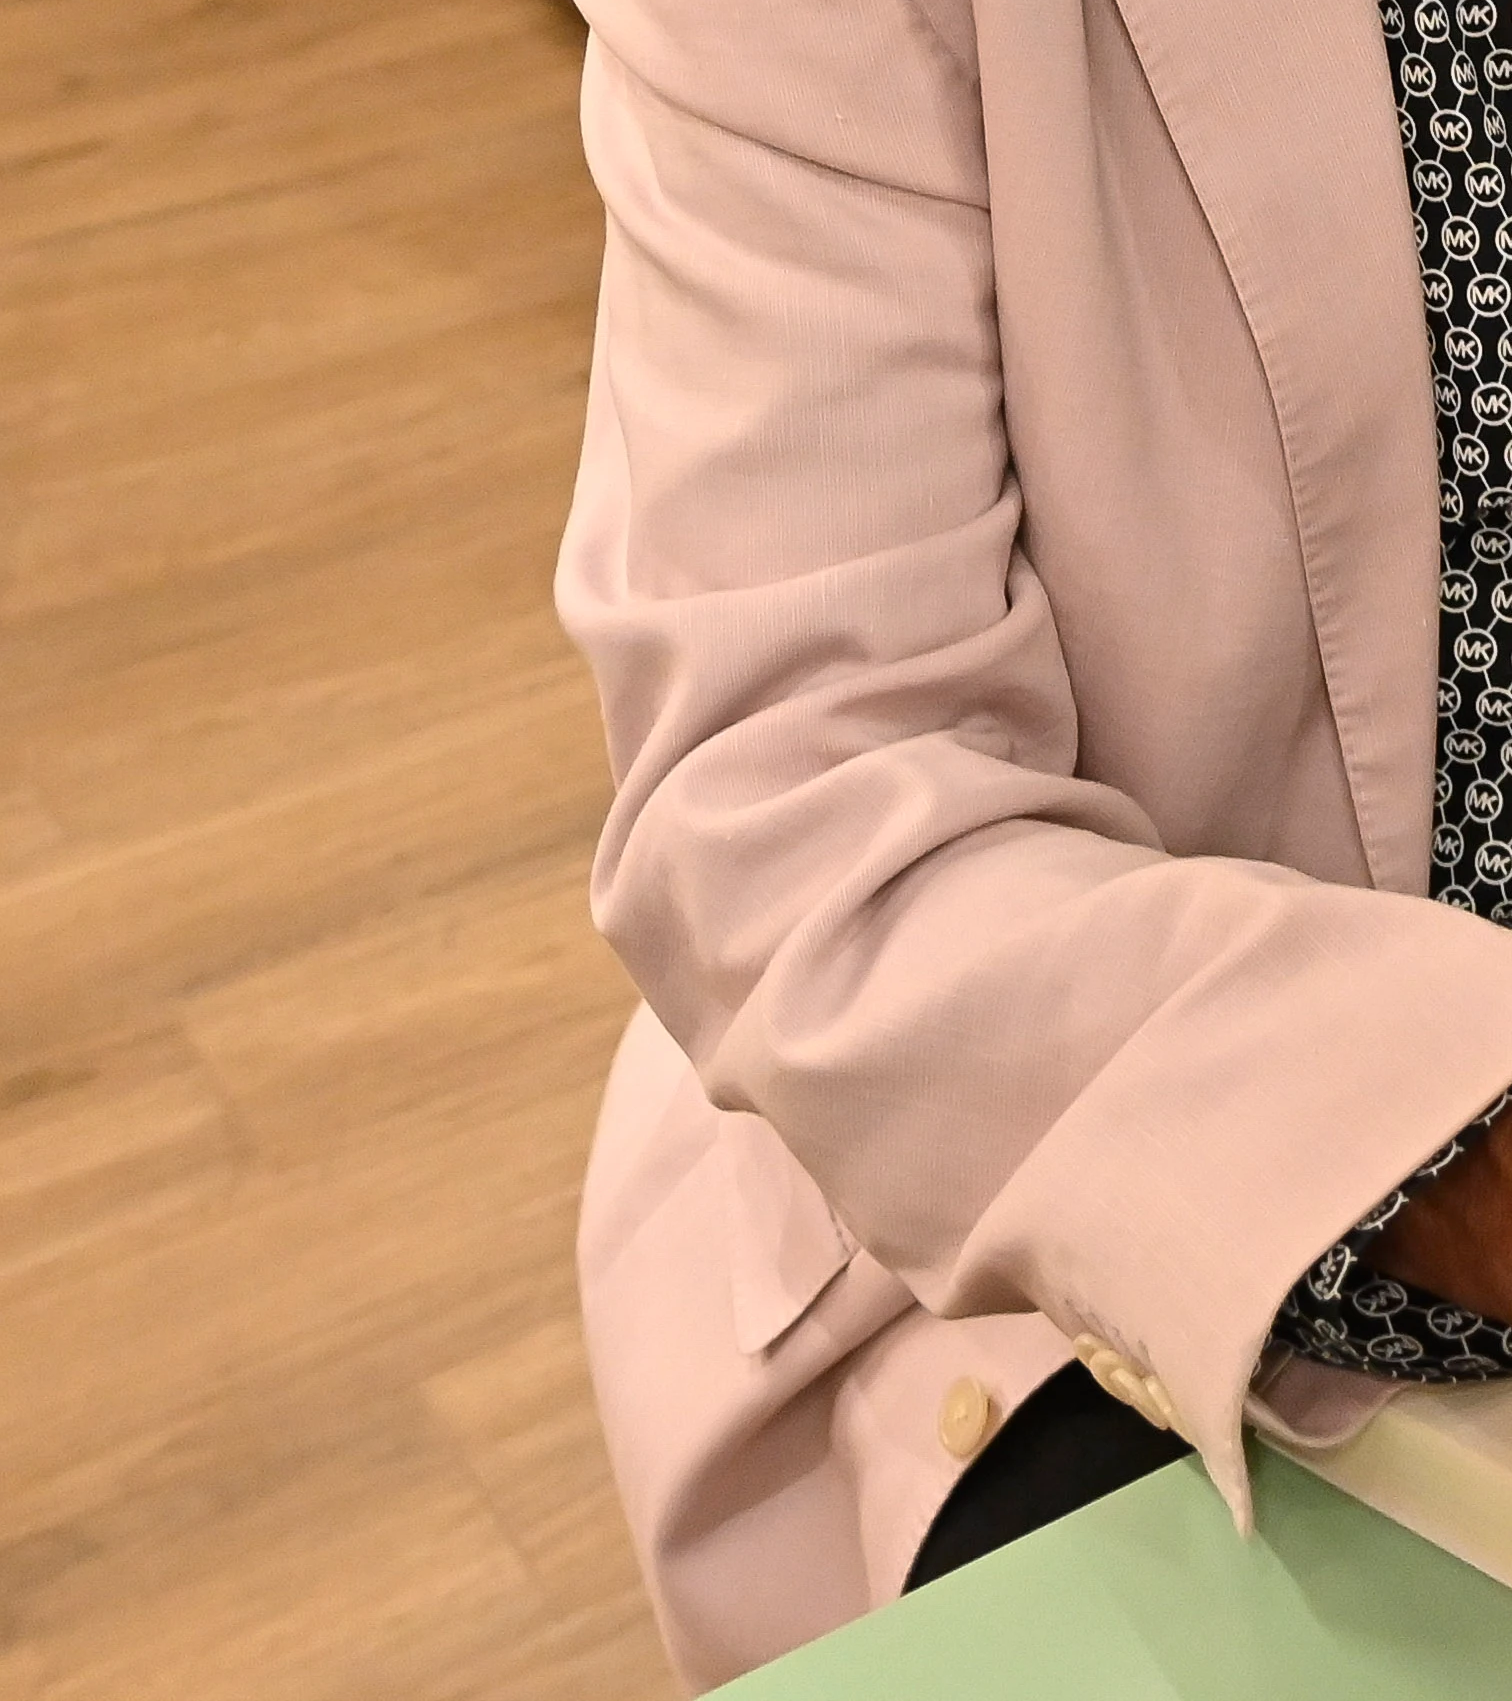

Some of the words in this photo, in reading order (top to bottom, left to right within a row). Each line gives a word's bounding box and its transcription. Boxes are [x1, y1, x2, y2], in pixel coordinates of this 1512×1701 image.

[1459, 4, 1490, 25] MK
[1403, 63, 1430, 85] MK
[1434, 120, 1465, 139] MK
[1416, 169, 1446, 191] MK
[1468, 172, 1501, 196] MK
[1445, 227, 1473, 248] MK
[1419, 281, 1447, 300] MK
[1471, 284, 1505, 304] MK
[1447, 337, 1475, 358] MK
[1475, 393, 1509, 413] MK
[1476, 536, 1508, 555] MK
[1439, 581, 1471, 602] MK
[1459, 640, 1491, 661] MK
[1481, 698, 1512, 717] MK
[1449, 738, 1481, 754] MK
[1467, 789, 1498, 813] MK
[1432, 834, 1460, 858] MK
[1479, 850, 1510, 877] MK
